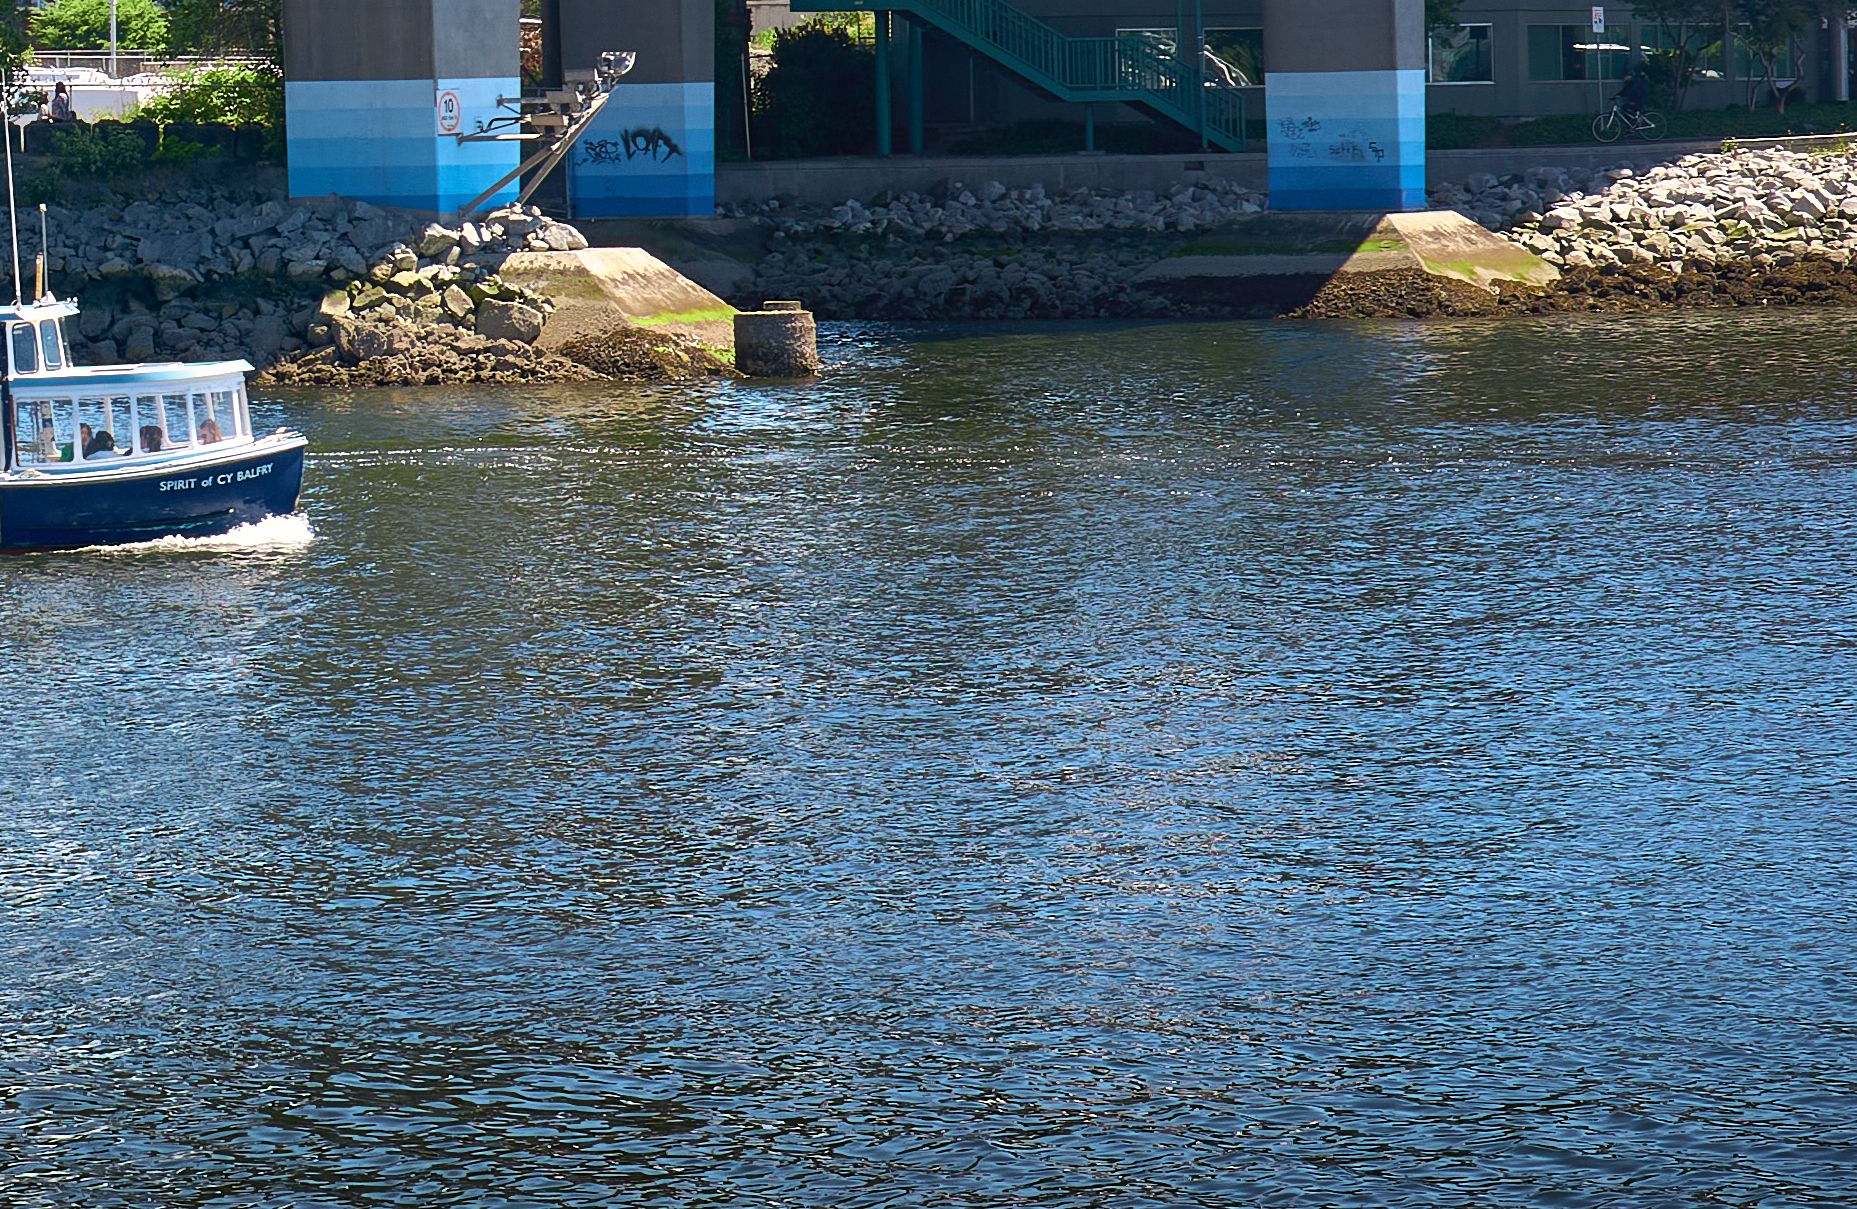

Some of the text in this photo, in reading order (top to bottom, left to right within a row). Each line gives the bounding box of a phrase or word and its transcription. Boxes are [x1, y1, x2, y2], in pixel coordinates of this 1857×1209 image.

[444, 98, 454, 113] 10
[160, 463, 273, 491] SPIRIT of CY BALFRY
